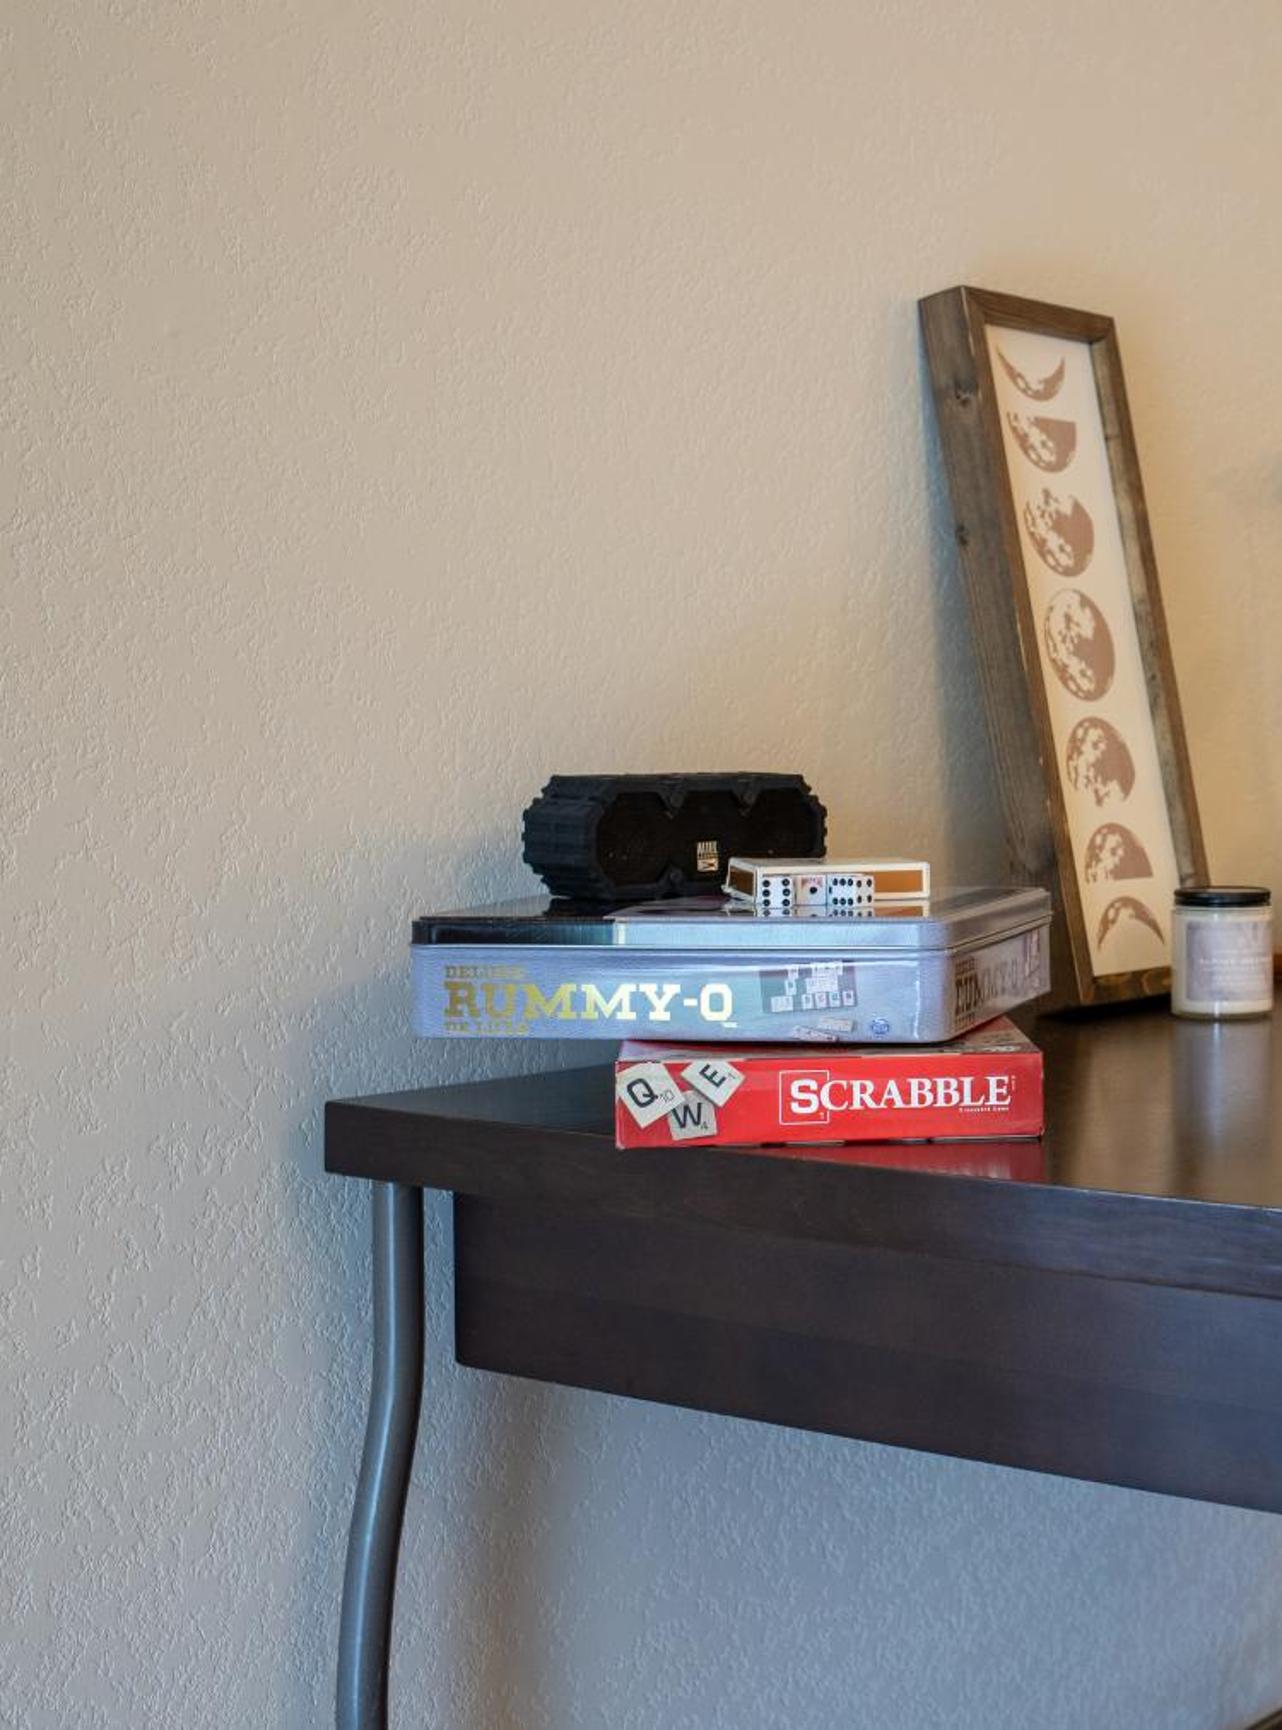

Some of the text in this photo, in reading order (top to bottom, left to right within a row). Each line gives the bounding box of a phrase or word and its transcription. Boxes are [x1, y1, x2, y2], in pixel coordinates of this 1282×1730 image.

[444, 981, 737, 1028] RUMMY-Q
[699, 1063, 726, 1088] E
[626, 1078, 658, 1108] Q
[790, 1075, 1012, 1114] SCRABBLE
[672, 1102, 702, 1128] W
